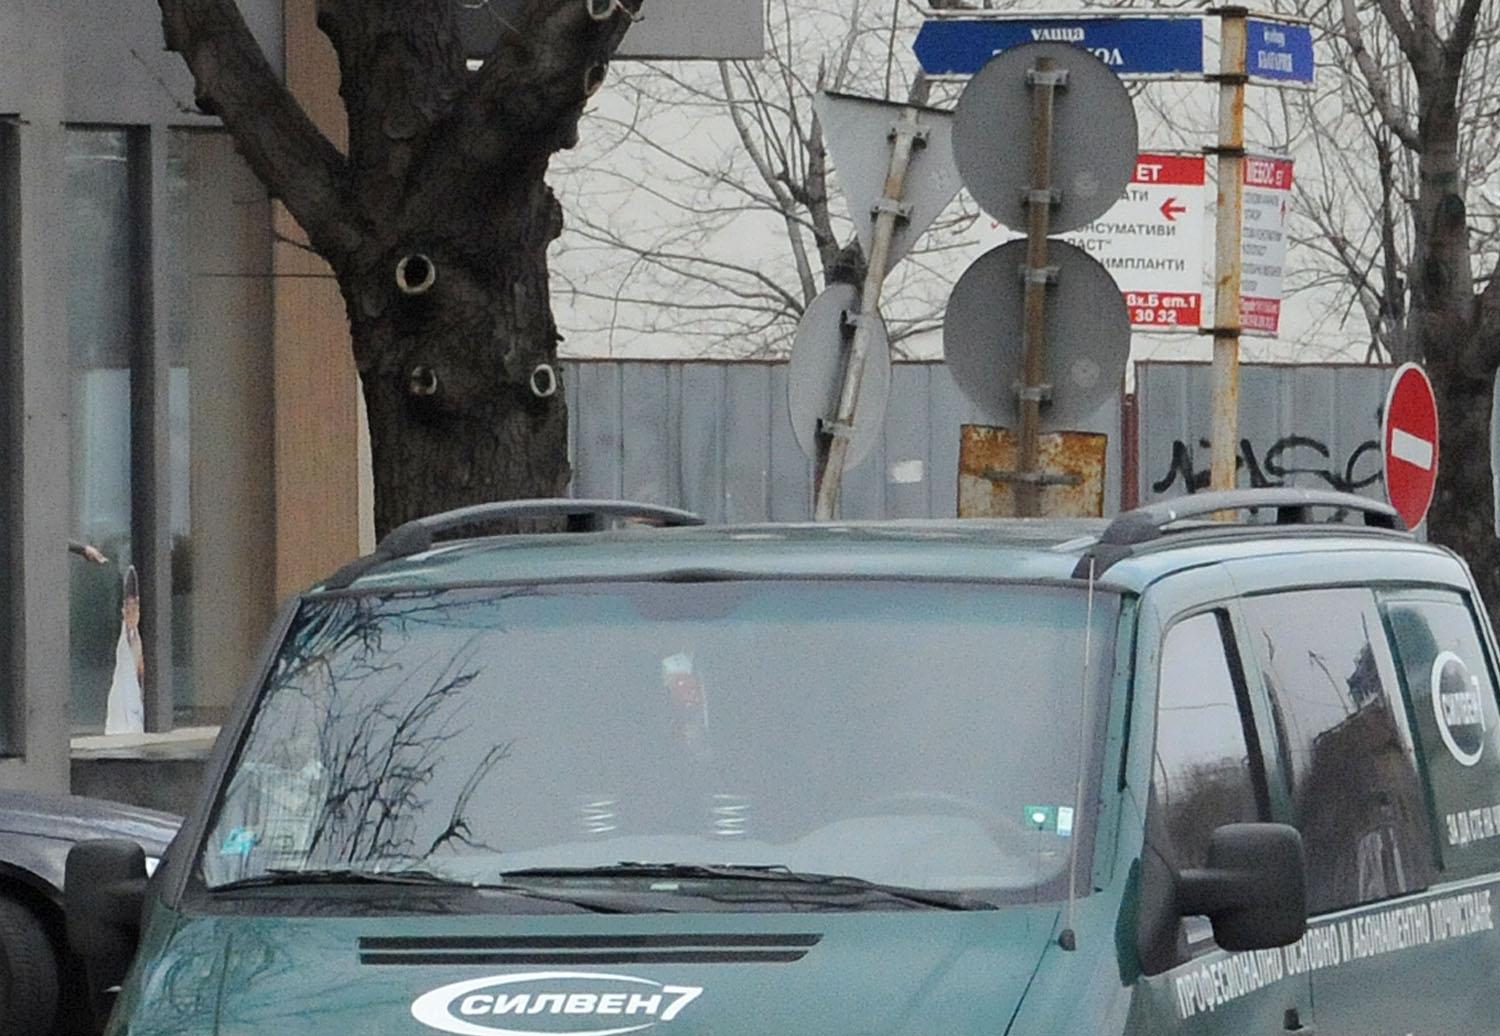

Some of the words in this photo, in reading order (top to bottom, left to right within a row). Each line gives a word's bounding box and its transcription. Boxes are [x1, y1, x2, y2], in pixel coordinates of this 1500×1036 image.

[1030, 27, 1085, 42] улица
[1136, 163, 1163, 181] ЕТ
[1135, 309, 1155, 323] 30
[1157, 310, 1177, 324] 32
